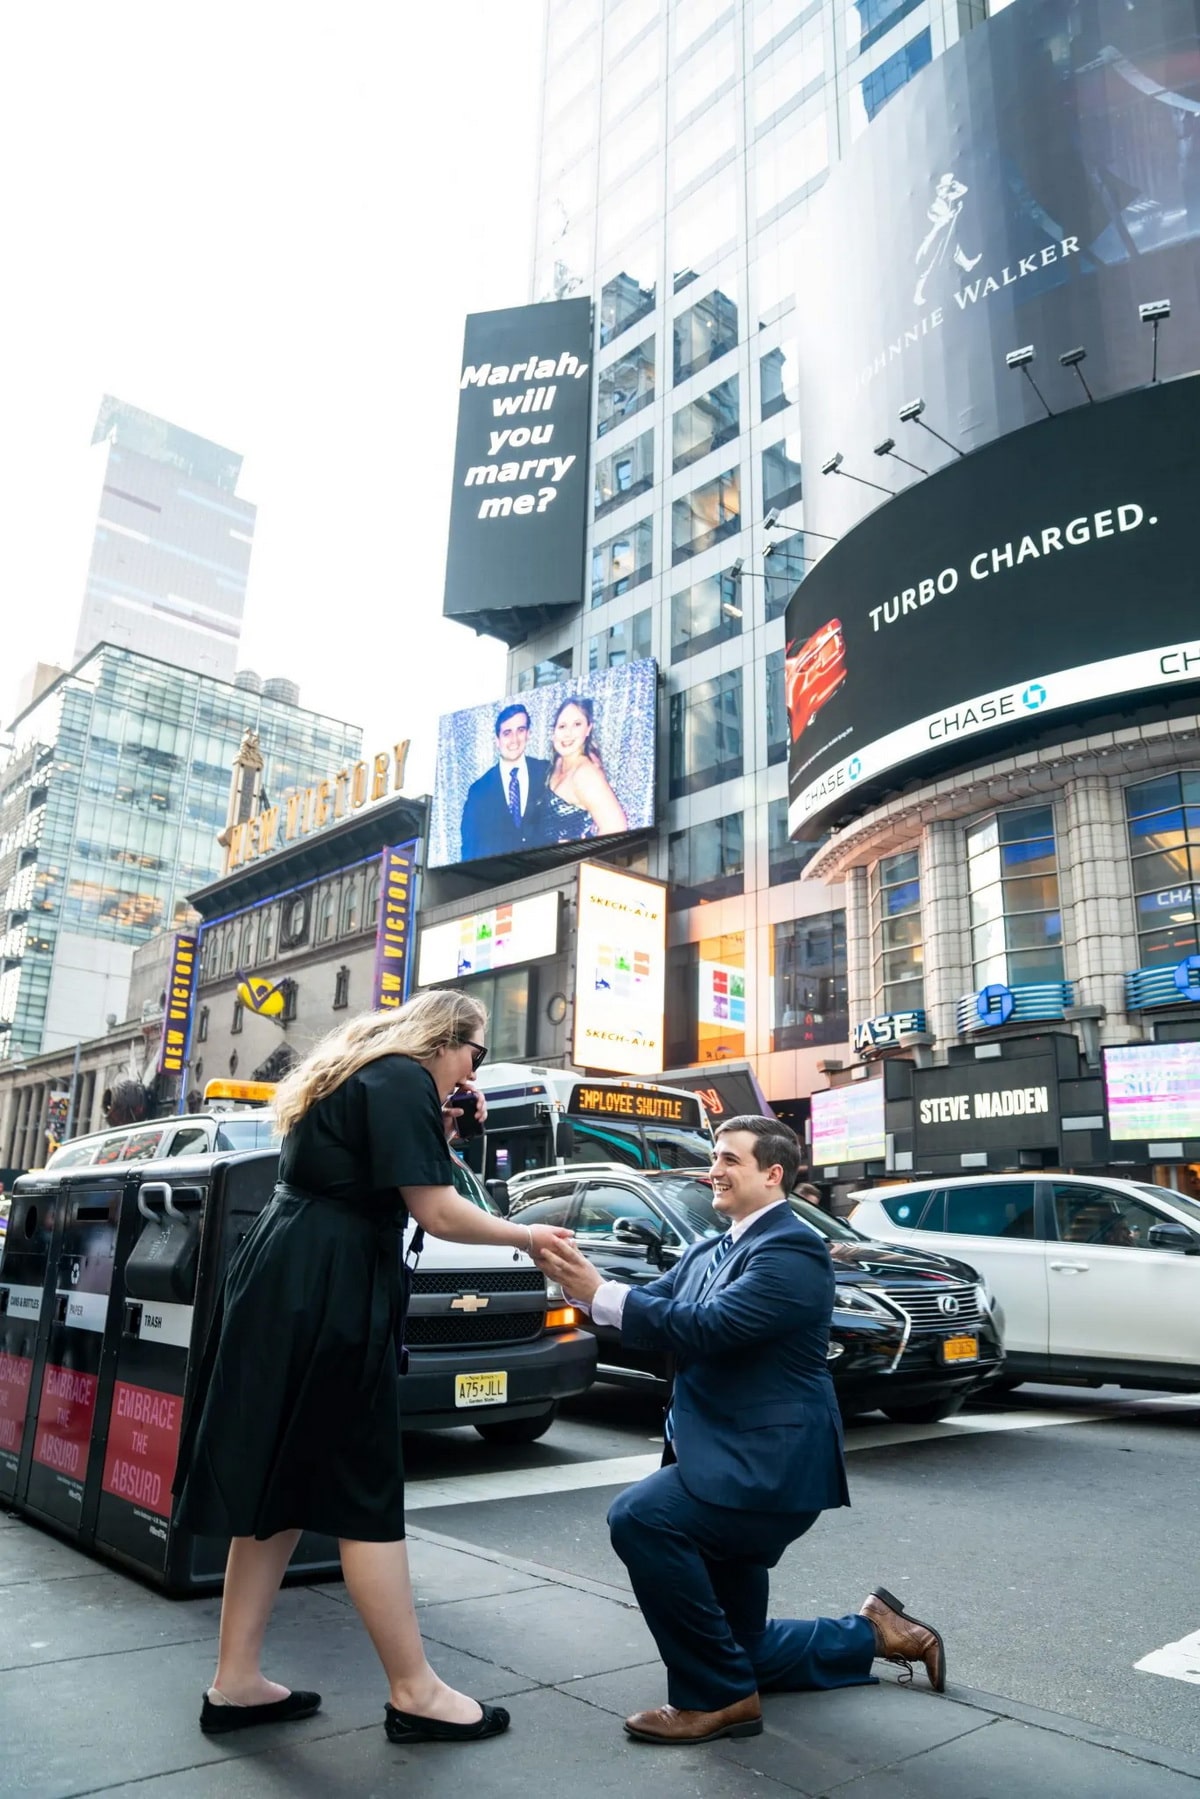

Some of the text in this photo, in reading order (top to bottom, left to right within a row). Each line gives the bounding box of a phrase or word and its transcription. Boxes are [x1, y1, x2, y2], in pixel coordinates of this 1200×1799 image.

[953, 236, 1080, 310] WALKER
[492, 385, 556, 417] will
[487, 424, 554, 455] you
[464, 455, 576, 486] marry
[477, 487, 556, 519] me?
[868, 503, 1159, 632] TURBO CHARGED.
[928, 694, 1015, 740] CHASE
[228, 739, 411, 868] NEW VICTORY
[805, 768, 845, 811] CHASE
[383, 854, 409, 958] VICTORY
[590, 896, 658, 920] SKECH-AIR
[164, 939, 193, 1070] VICTORY NEW
[585, 1029, 655, 1048] SKECH-AIR
[579, 1088, 682, 1119] EMPLOYEE SHUTTLE
[920, 1086, 1048, 1124] STEVE MADDEN
[144, 1314, 163, 1328] TRASH
[46, 1369, 92, 1405] EMBRACE
[56, 1407, 70, 1428] THE
[116, 1387, 176, 1430] EMBRACE
[40, 1432, 79, 1472] ABSURD
[131, 1431, 148, 1455] THE
[110, 1458, 161, 1506] ABSURD
